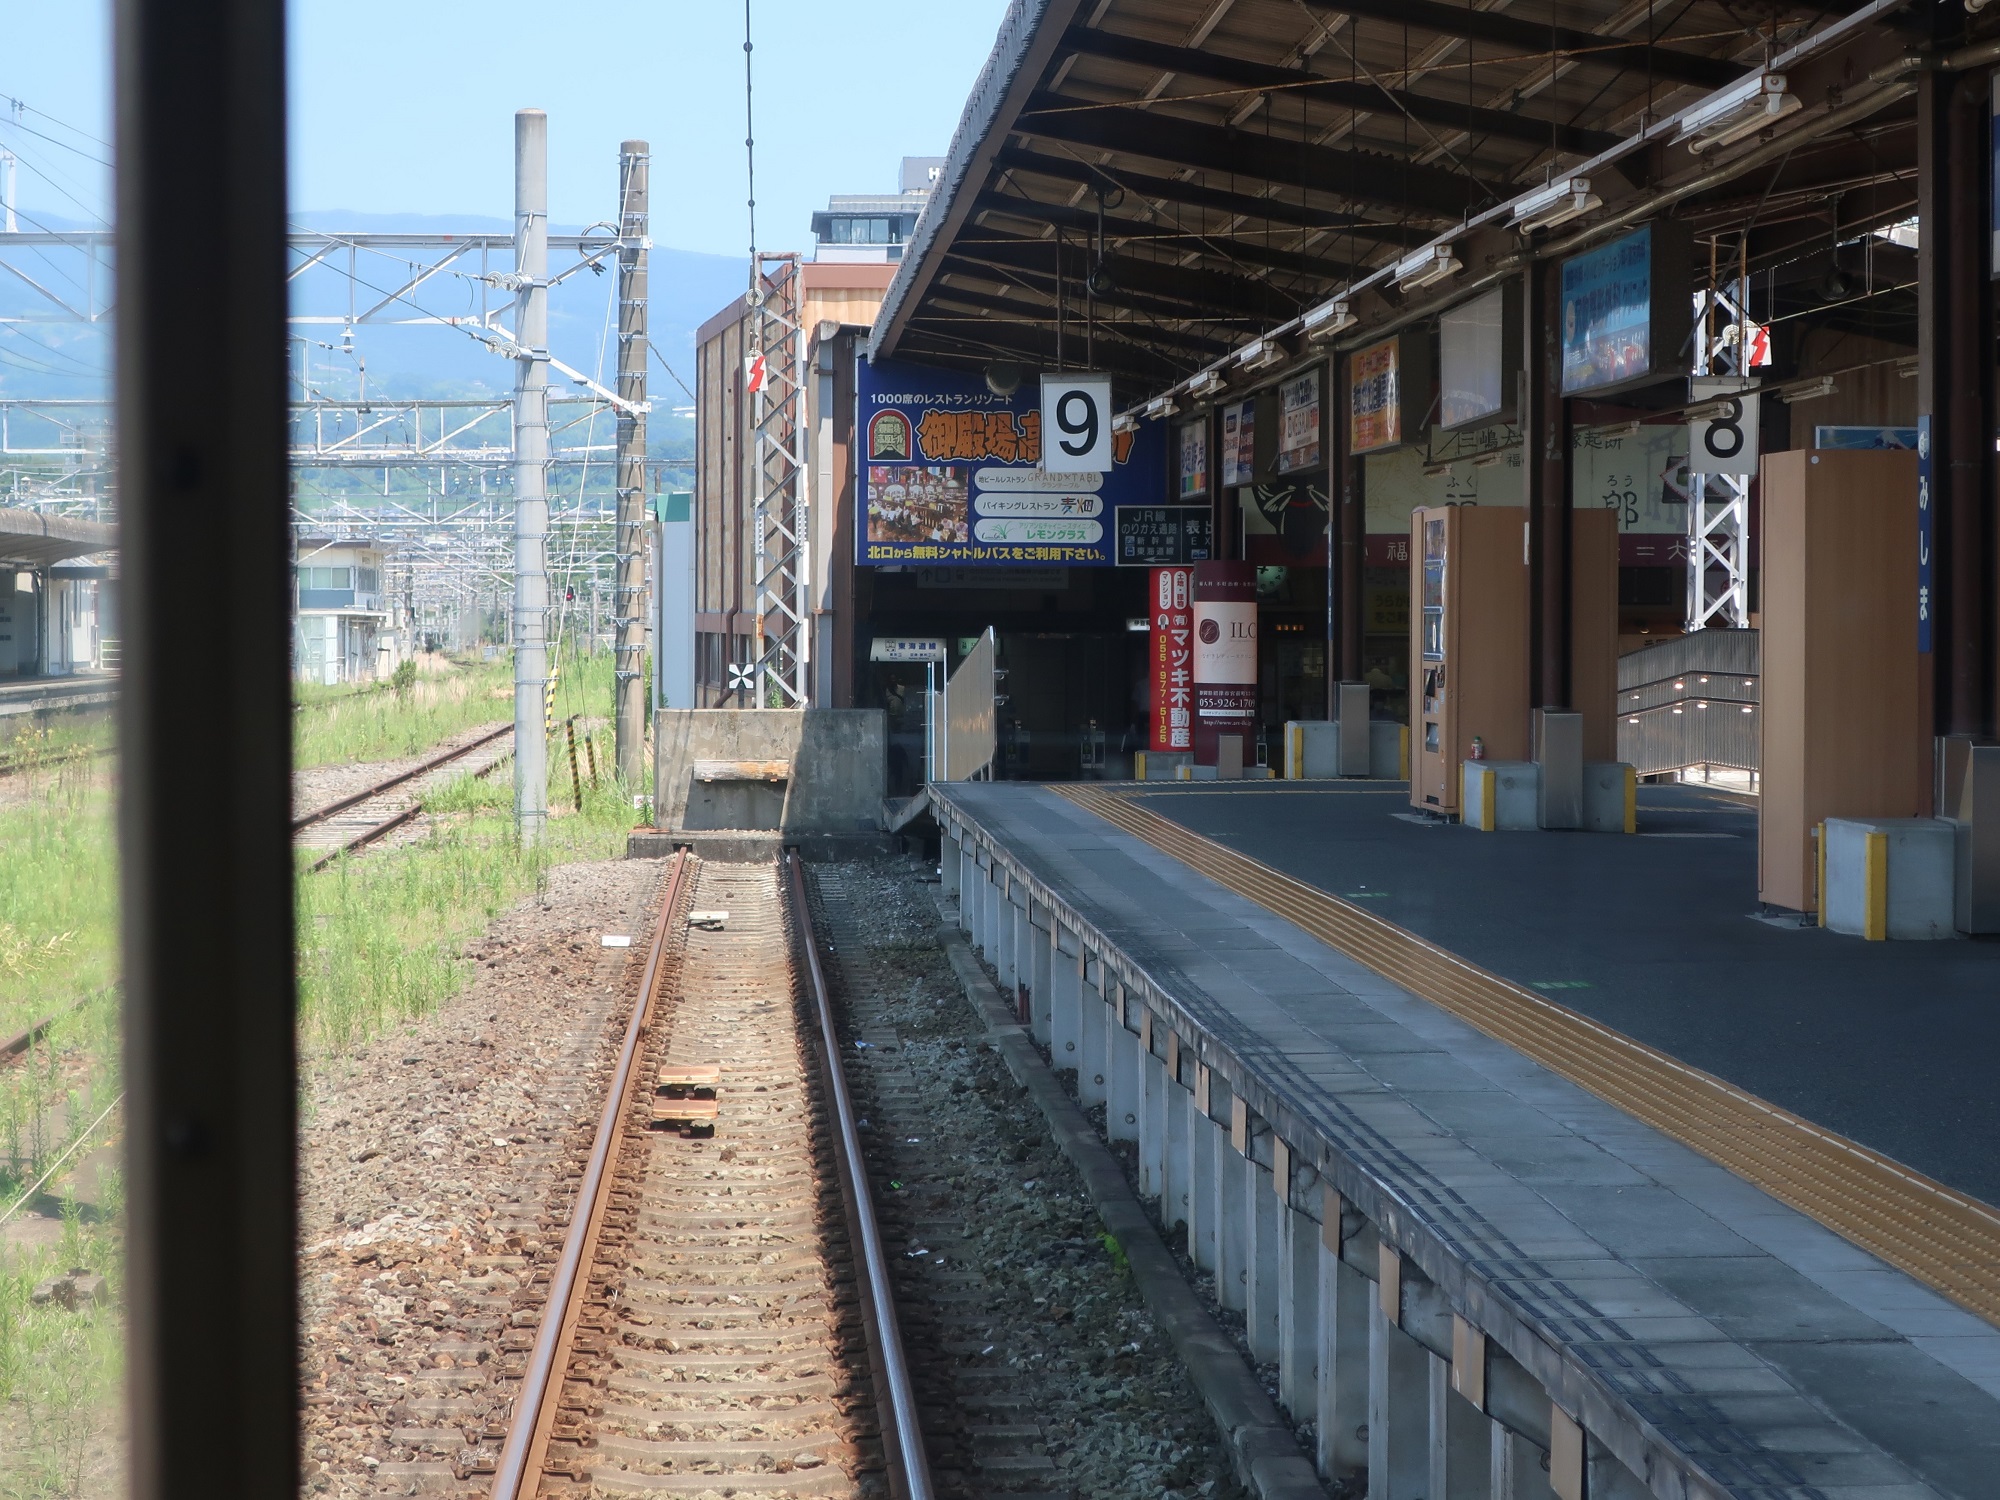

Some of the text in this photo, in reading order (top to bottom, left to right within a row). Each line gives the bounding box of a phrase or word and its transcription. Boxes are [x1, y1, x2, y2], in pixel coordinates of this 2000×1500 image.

[871, 393, 1013, 405] 1000席のレストランリゾート
[1057, 390, 1099, 457] 9
[1704, 393, 1745, 459] 8
[979, 476, 1026, 484] 地ビールレストラン
[1447, 475, 1473, 488] ふく
[1607, 475, 1633, 487] ろう
[983, 497, 1093, 515] バイキングレストラン 麦畑
[1133, 510, 1166, 522] JR線
[1027, 530, 1087, 540] レモングラス
[1121, 523, 1177, 535] のりかえ通路
[1137, 536, 1174, 545] 新幹線
[867, 546, 1106, 561] 北口から無料シャトルバスをご利用下さい。
[1137, 546, 1174, 556] 東海道線
[1919, 475, 1928, 621] みしま
[898, 642, 936, 650] 東海道線
